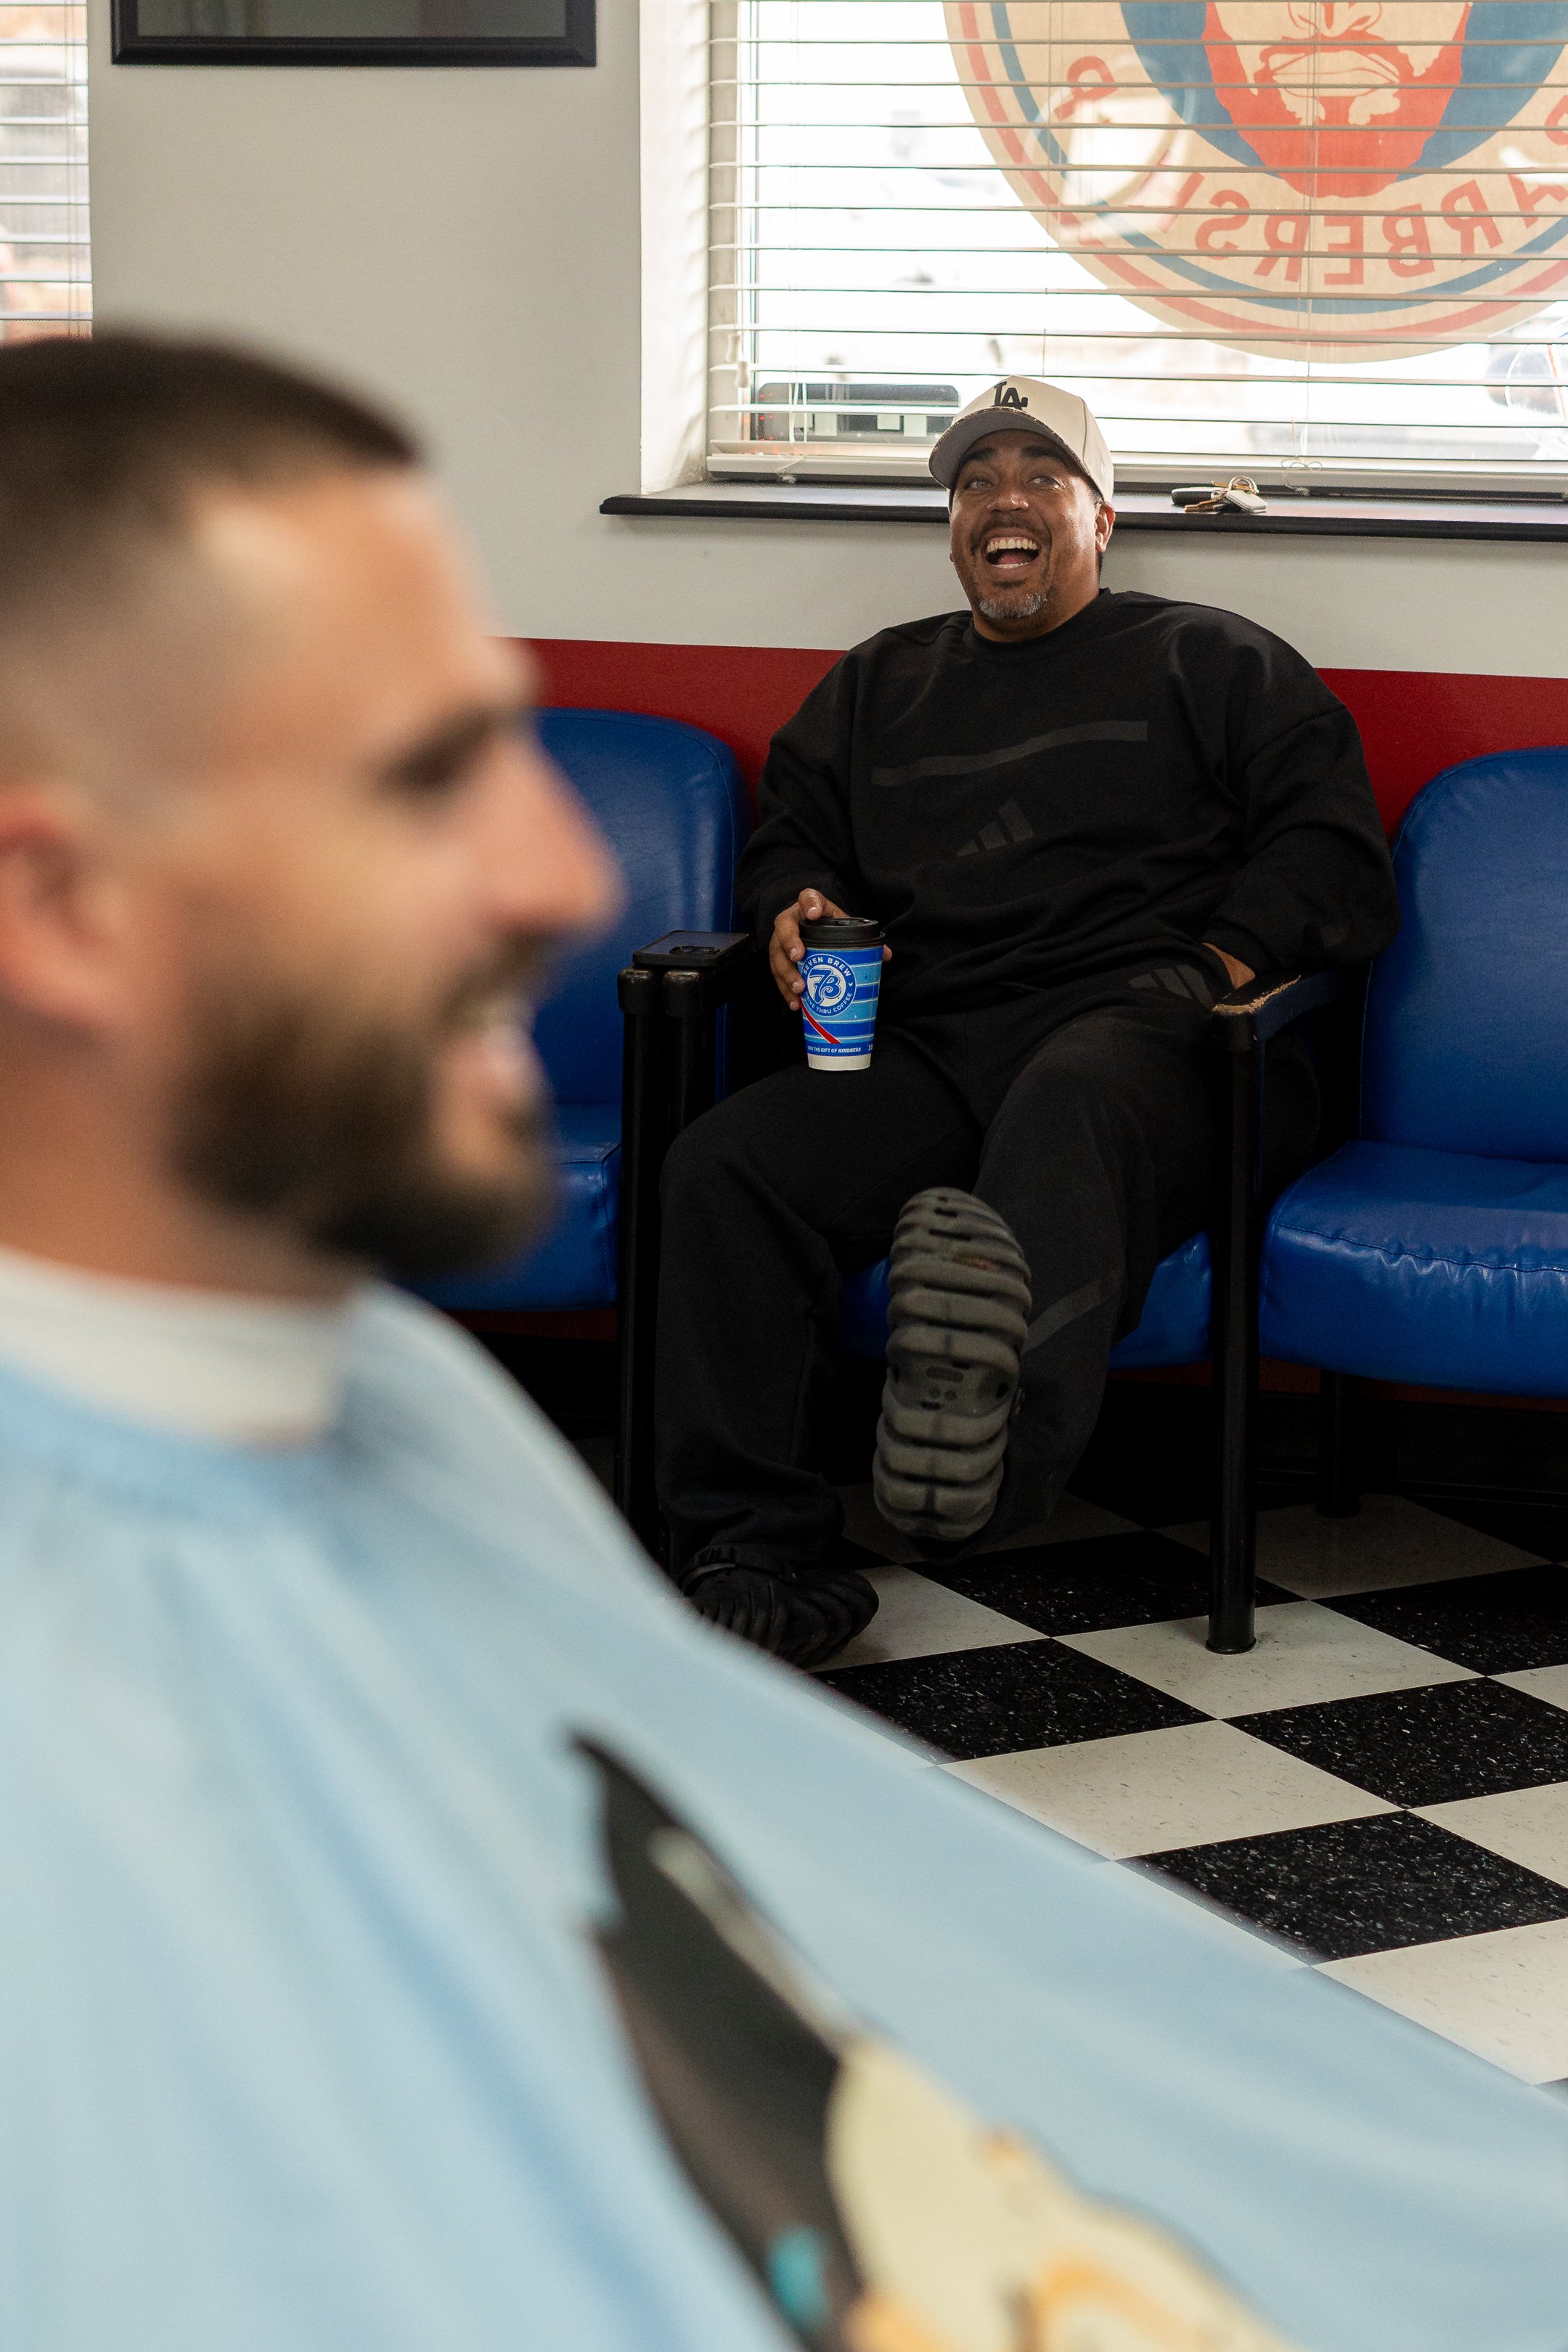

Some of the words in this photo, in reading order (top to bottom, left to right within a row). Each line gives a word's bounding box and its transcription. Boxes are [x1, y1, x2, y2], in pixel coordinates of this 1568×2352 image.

[991, 381, 1028, 412] LA
[804, 957, 823, 975] SEVEN
[828, 957, 852, 976] BREW
[805, 991, 816, 1009] DRIVE
[833, 992, 852, 1013] COFFEE
